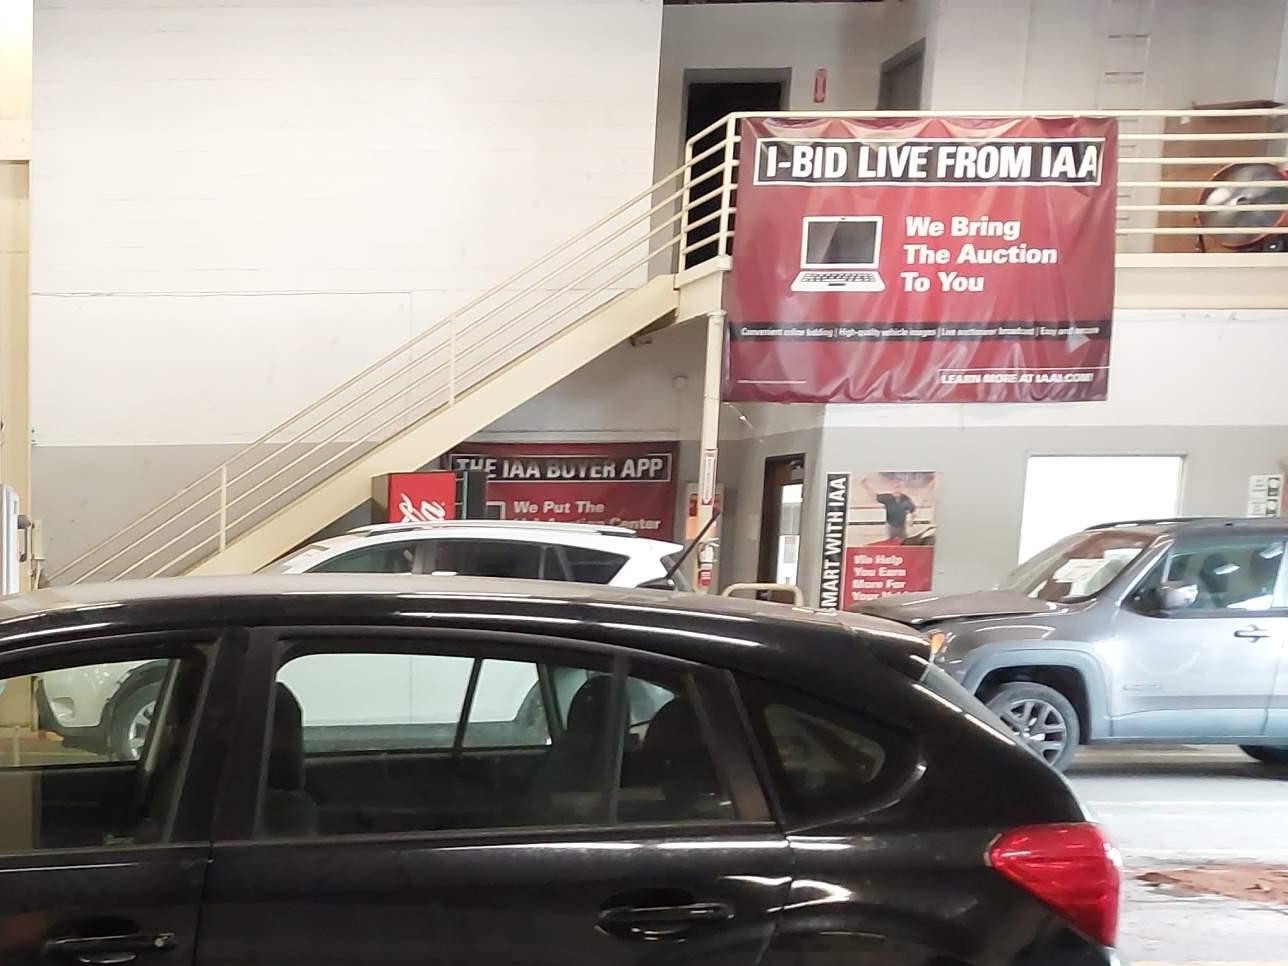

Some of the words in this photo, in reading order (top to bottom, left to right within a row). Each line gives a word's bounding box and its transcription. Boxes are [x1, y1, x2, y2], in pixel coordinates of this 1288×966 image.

[765, 145, 848, 178] I-BID
[857, 145, 933, 178] LIVE
[937, 145, 1032, 178] FROM
[1040, 144, 1100, 179] IAA
[905, 216, 945, 237] We
[951, 216, 1021, 240] Bring
[903, 244, 955, 264] The
[958, 244, 1058, 264] Auction
[900, 271, 930, 292] To
[939, 271, 985, 292] You
[941, 374, 981, 384] LEARN
[1019, 373, 1034, 383] AT
[502, 459, 541, 479] IAA
[546, 458, 616, 479] BUYER
[620, 458, 663, 478] APP
[827, 477, 846, 507] IAA
[513, 500, 539, 513] We
[543, 500, 570, 513] Put
[575, 500, 605, 513] The
[823, 511, 844, 556] WITH
[875, 554, 903, 566] Help
[853, 567, 876, 577] You
[878, 566, 906, 577] Earn
[885, 579, 906, 589] For
